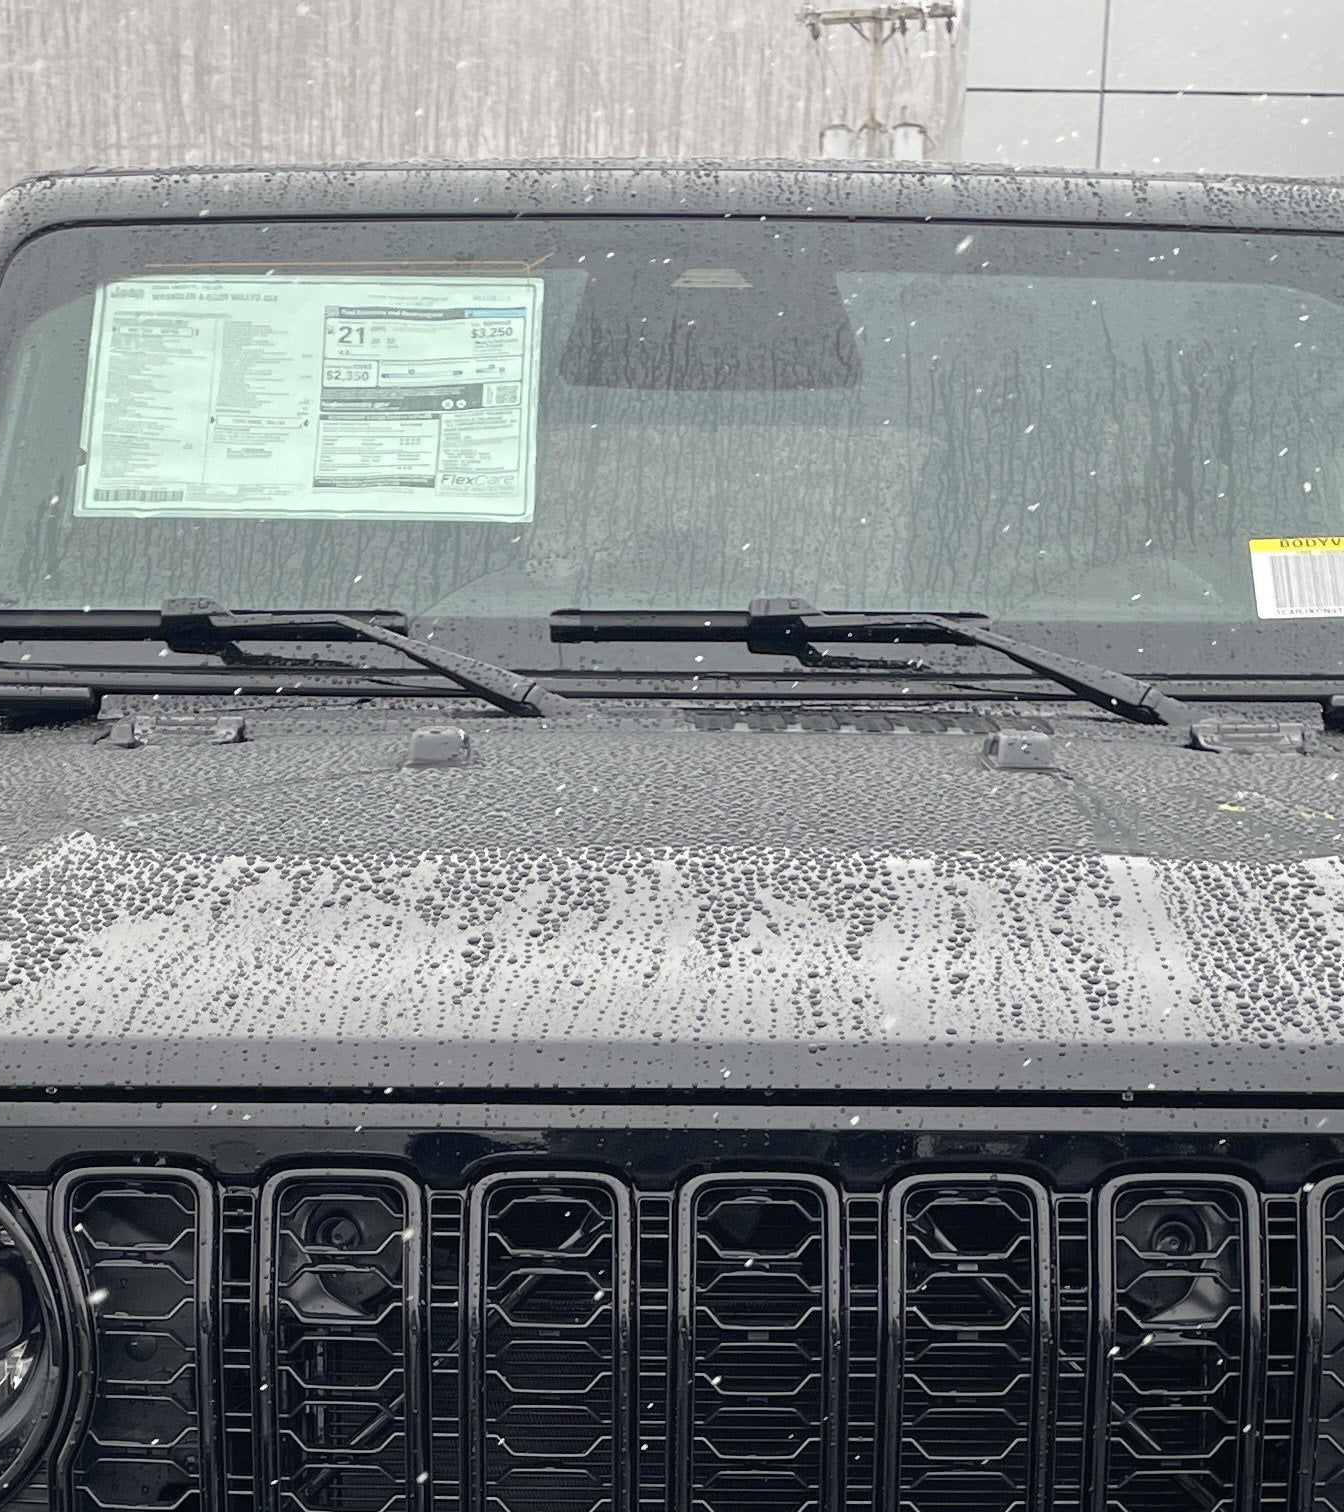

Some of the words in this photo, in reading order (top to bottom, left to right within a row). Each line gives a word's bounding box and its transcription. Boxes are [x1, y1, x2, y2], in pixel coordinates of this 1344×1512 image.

[338, 325, 365, 344] 21
[470, 326, 514, 339] $3,250
[326, 370, 369, 382] $2,350
[440, 474, 515, 486] FlexCare
